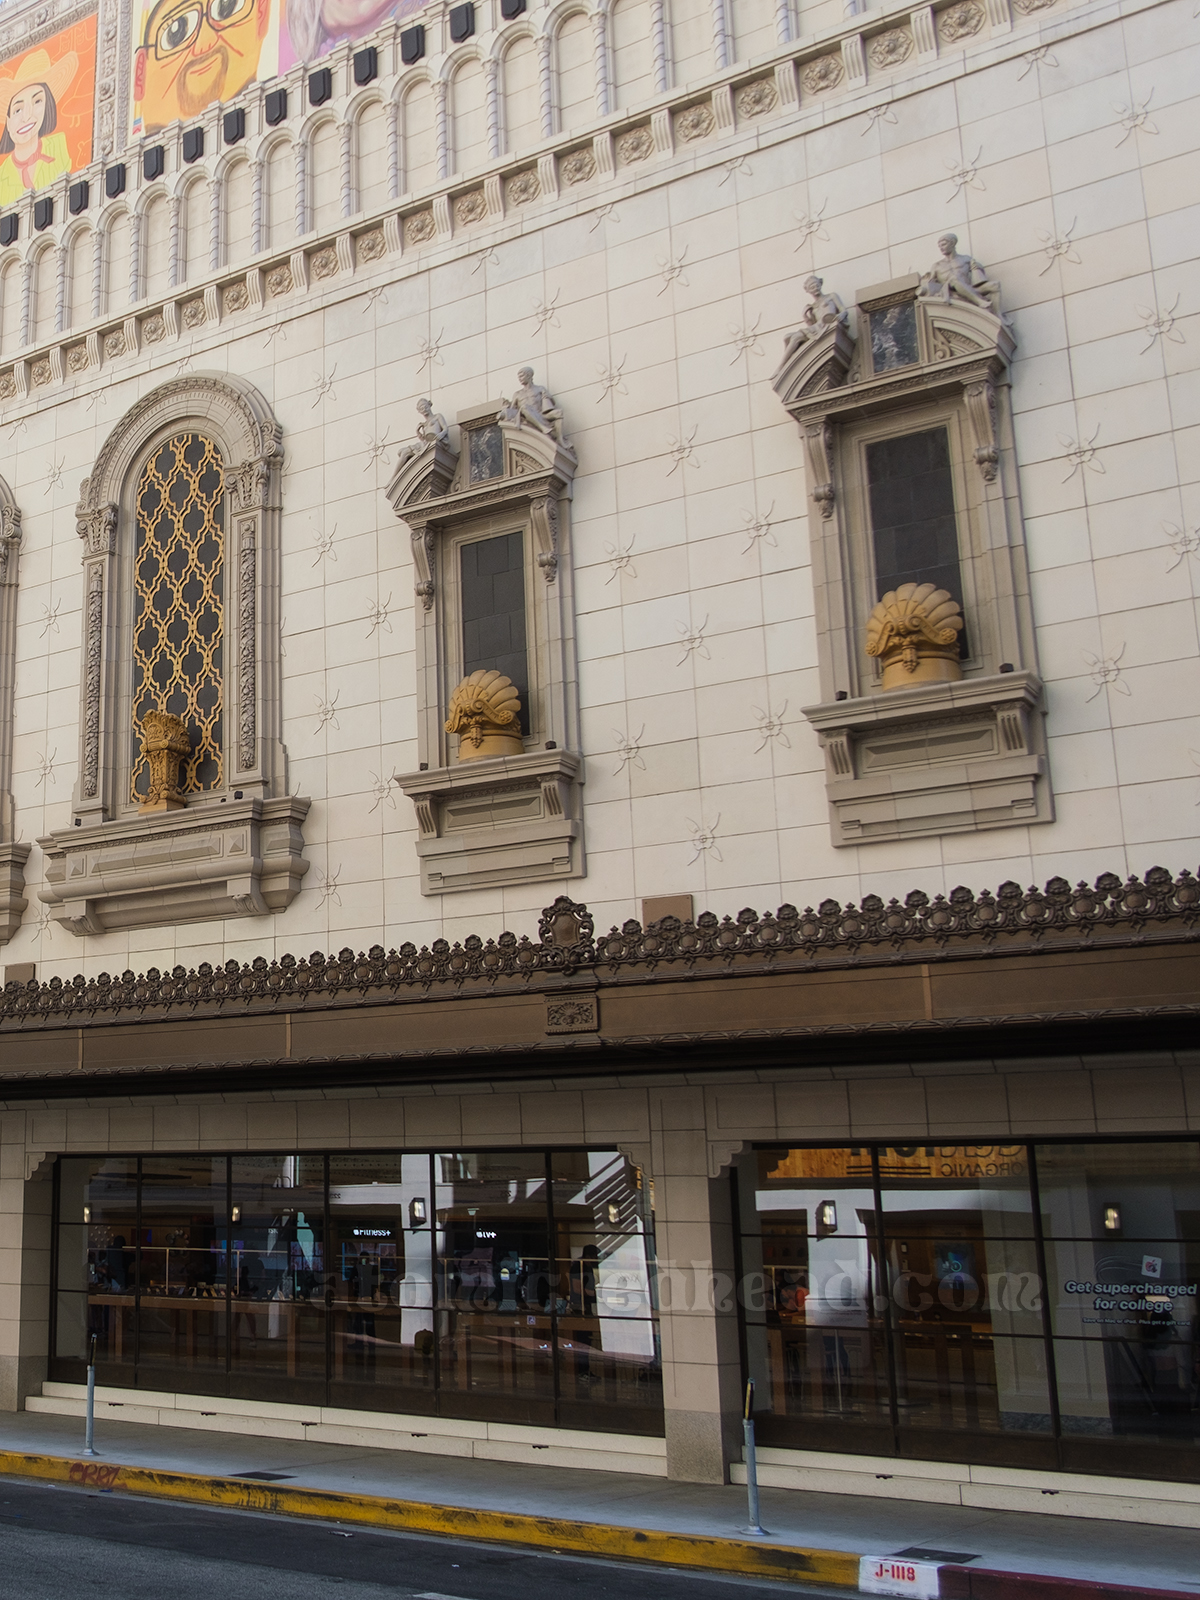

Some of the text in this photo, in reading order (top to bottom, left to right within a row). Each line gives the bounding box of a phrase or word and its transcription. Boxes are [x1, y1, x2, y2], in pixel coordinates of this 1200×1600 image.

[1066, 1281, 1197, 1296] Get supercharged
[1095, 1298, 1173, 1313] for college
